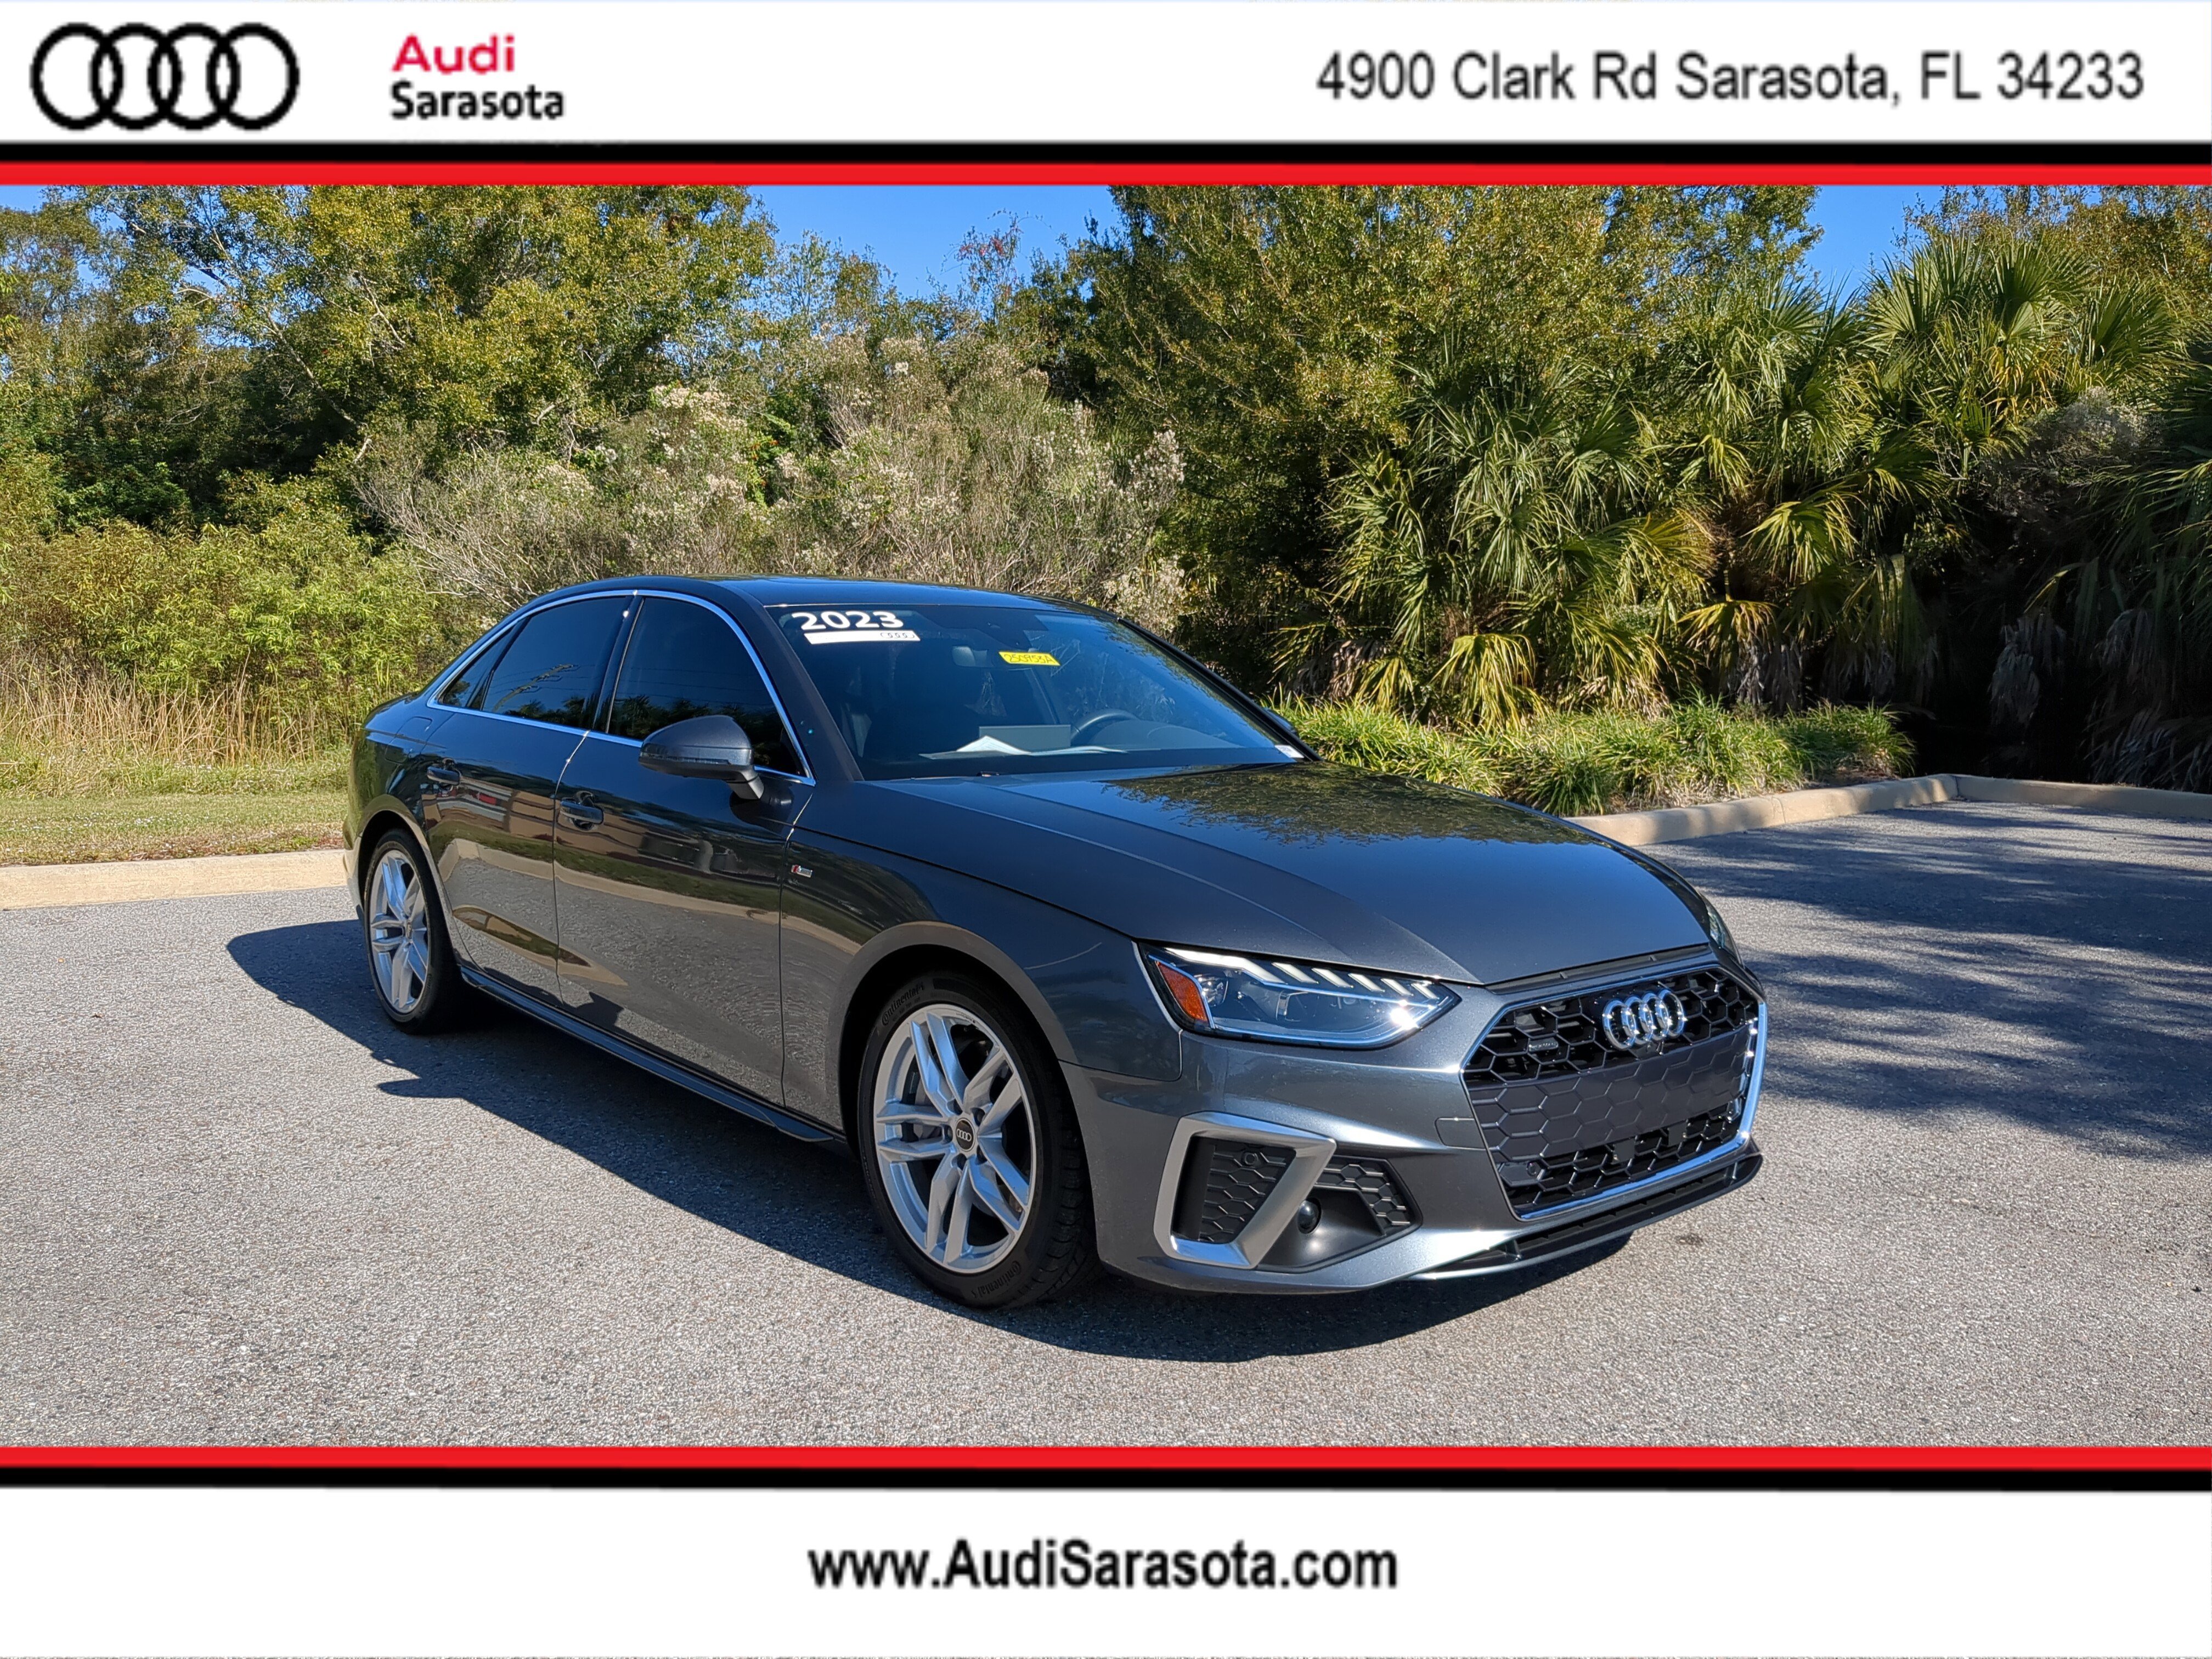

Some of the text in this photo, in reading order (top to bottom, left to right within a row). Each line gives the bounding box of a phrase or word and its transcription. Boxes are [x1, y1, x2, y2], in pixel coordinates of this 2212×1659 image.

[791, 610, 904, 630] 2023
[881, 983, 920, 1026] Continental
[977, 1260, 1021, 1297] Continental
